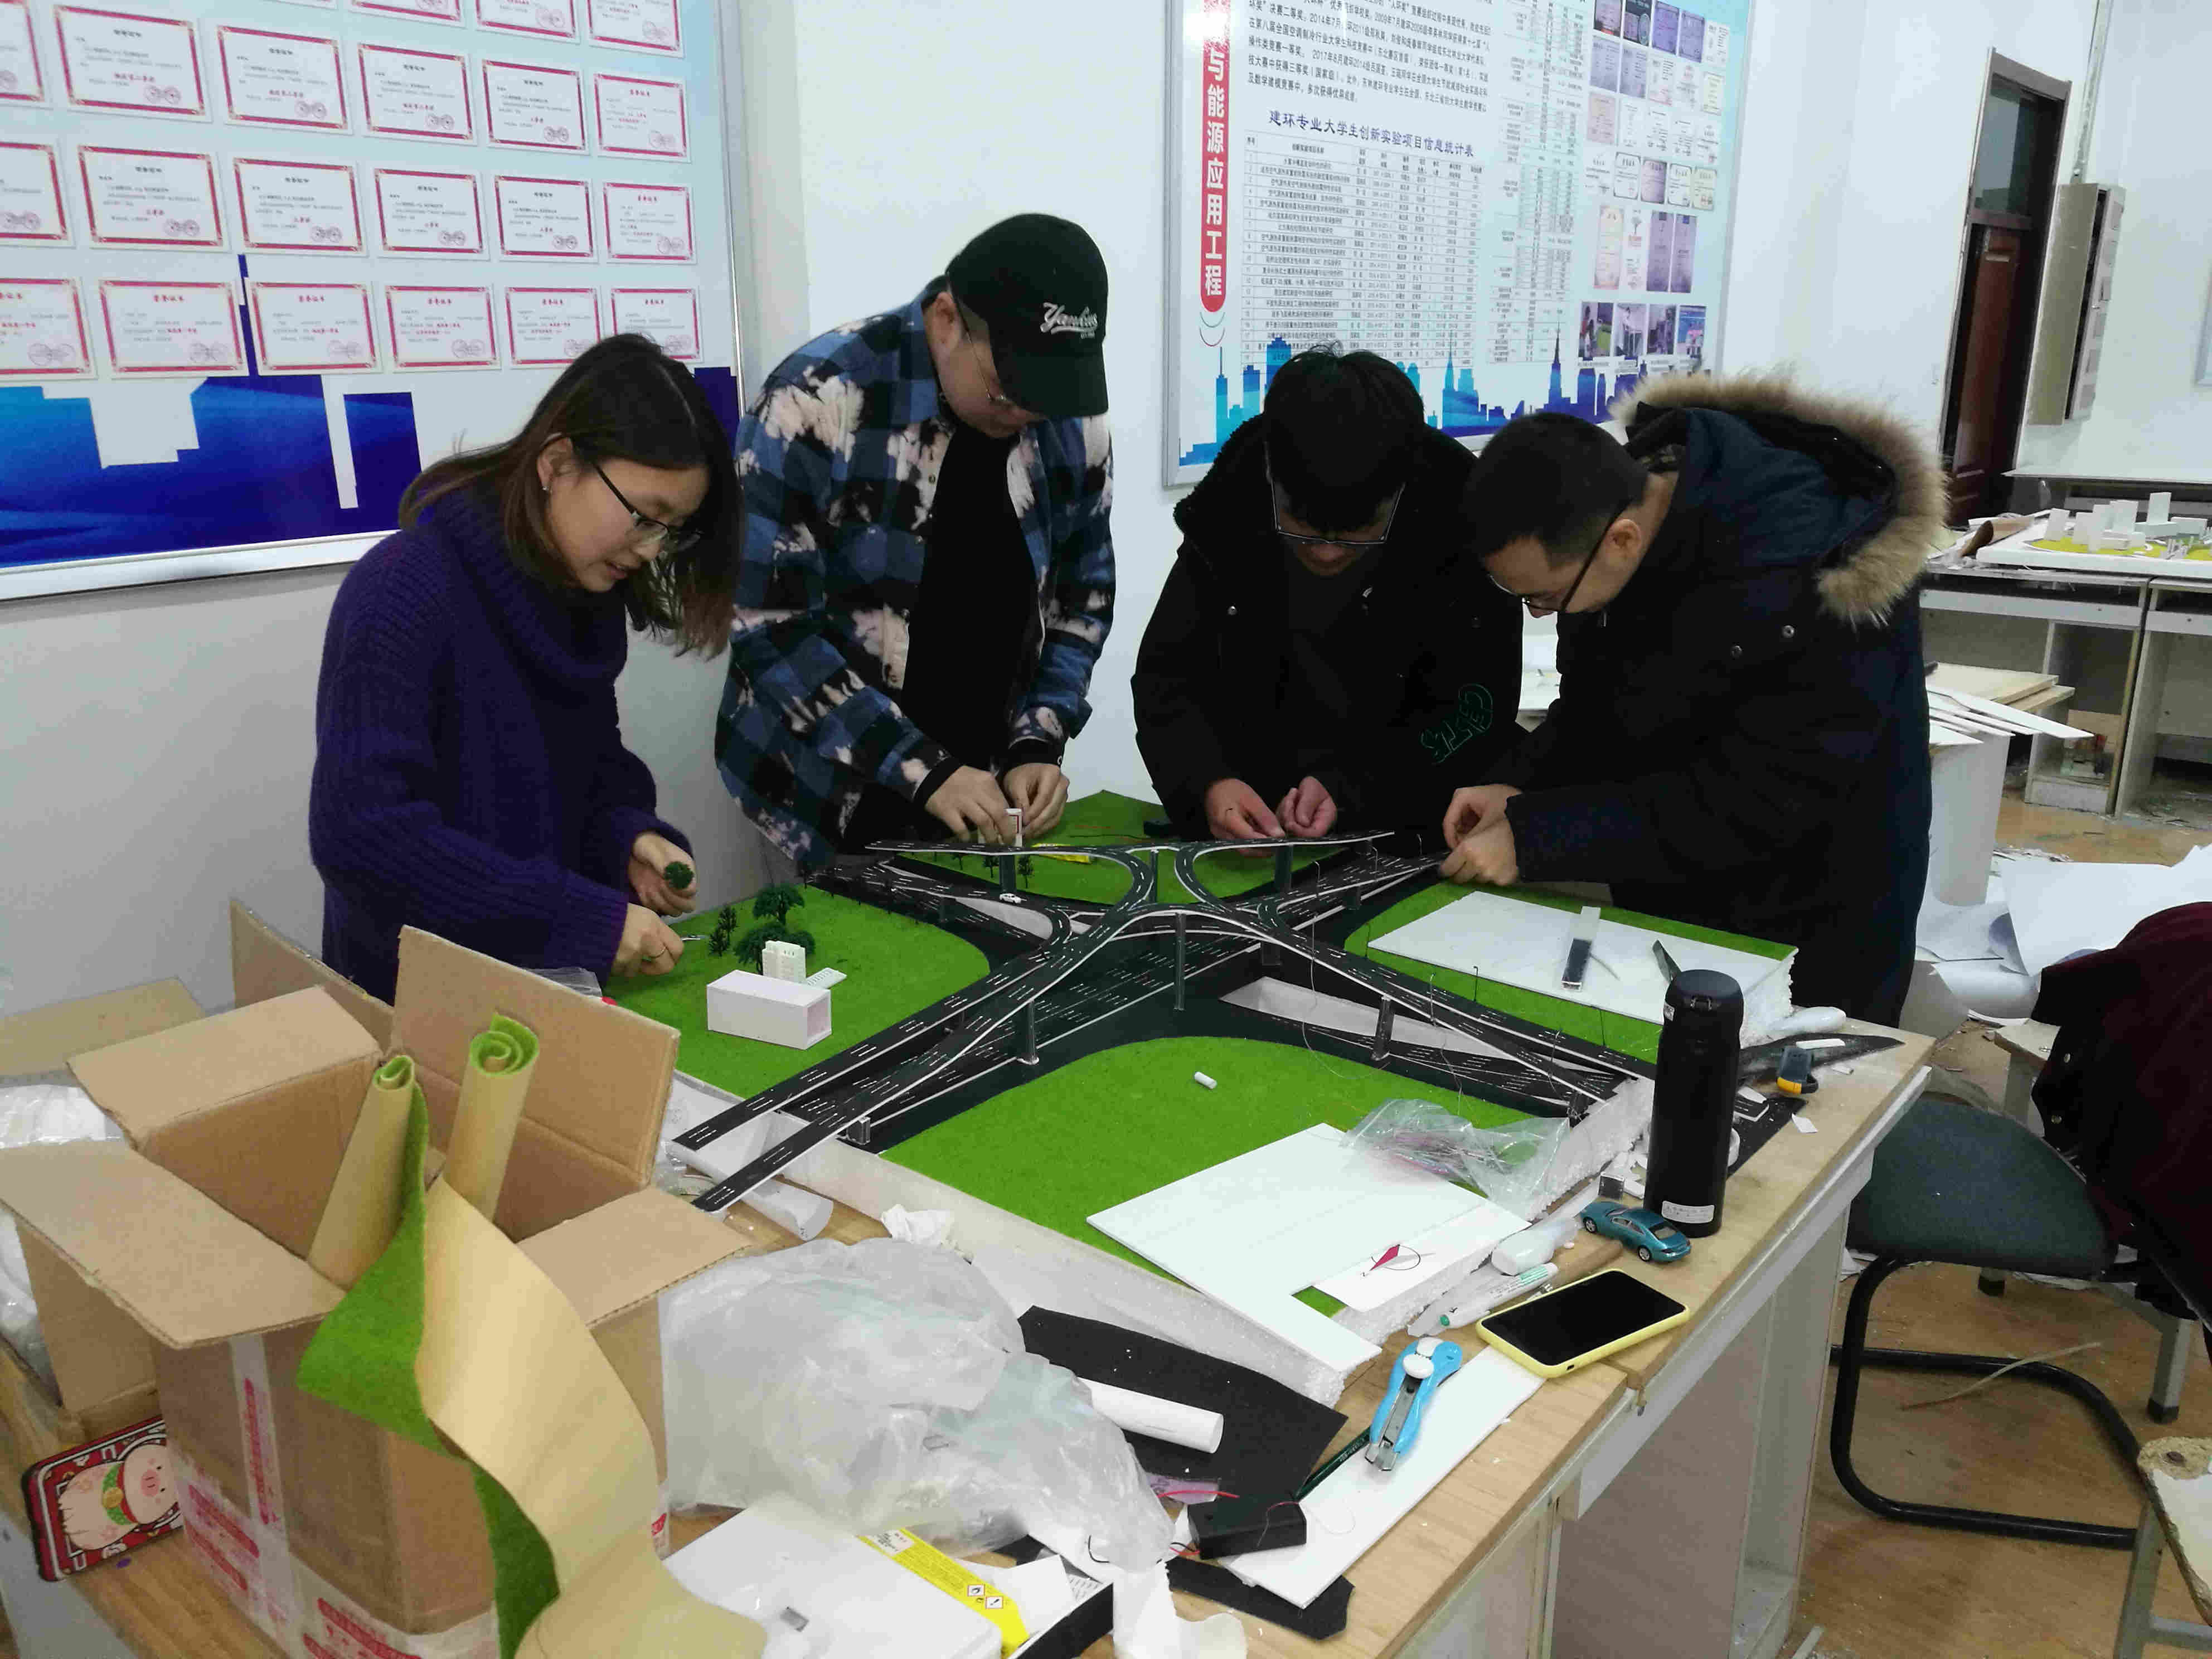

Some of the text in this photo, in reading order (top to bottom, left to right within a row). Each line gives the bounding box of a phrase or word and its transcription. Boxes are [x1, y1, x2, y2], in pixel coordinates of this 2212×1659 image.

[1205, 48, 1225, 296] 与能源应用工程
[1269, 110, 1474, 158] 建环专业大学生创新实验项目信息统计表
